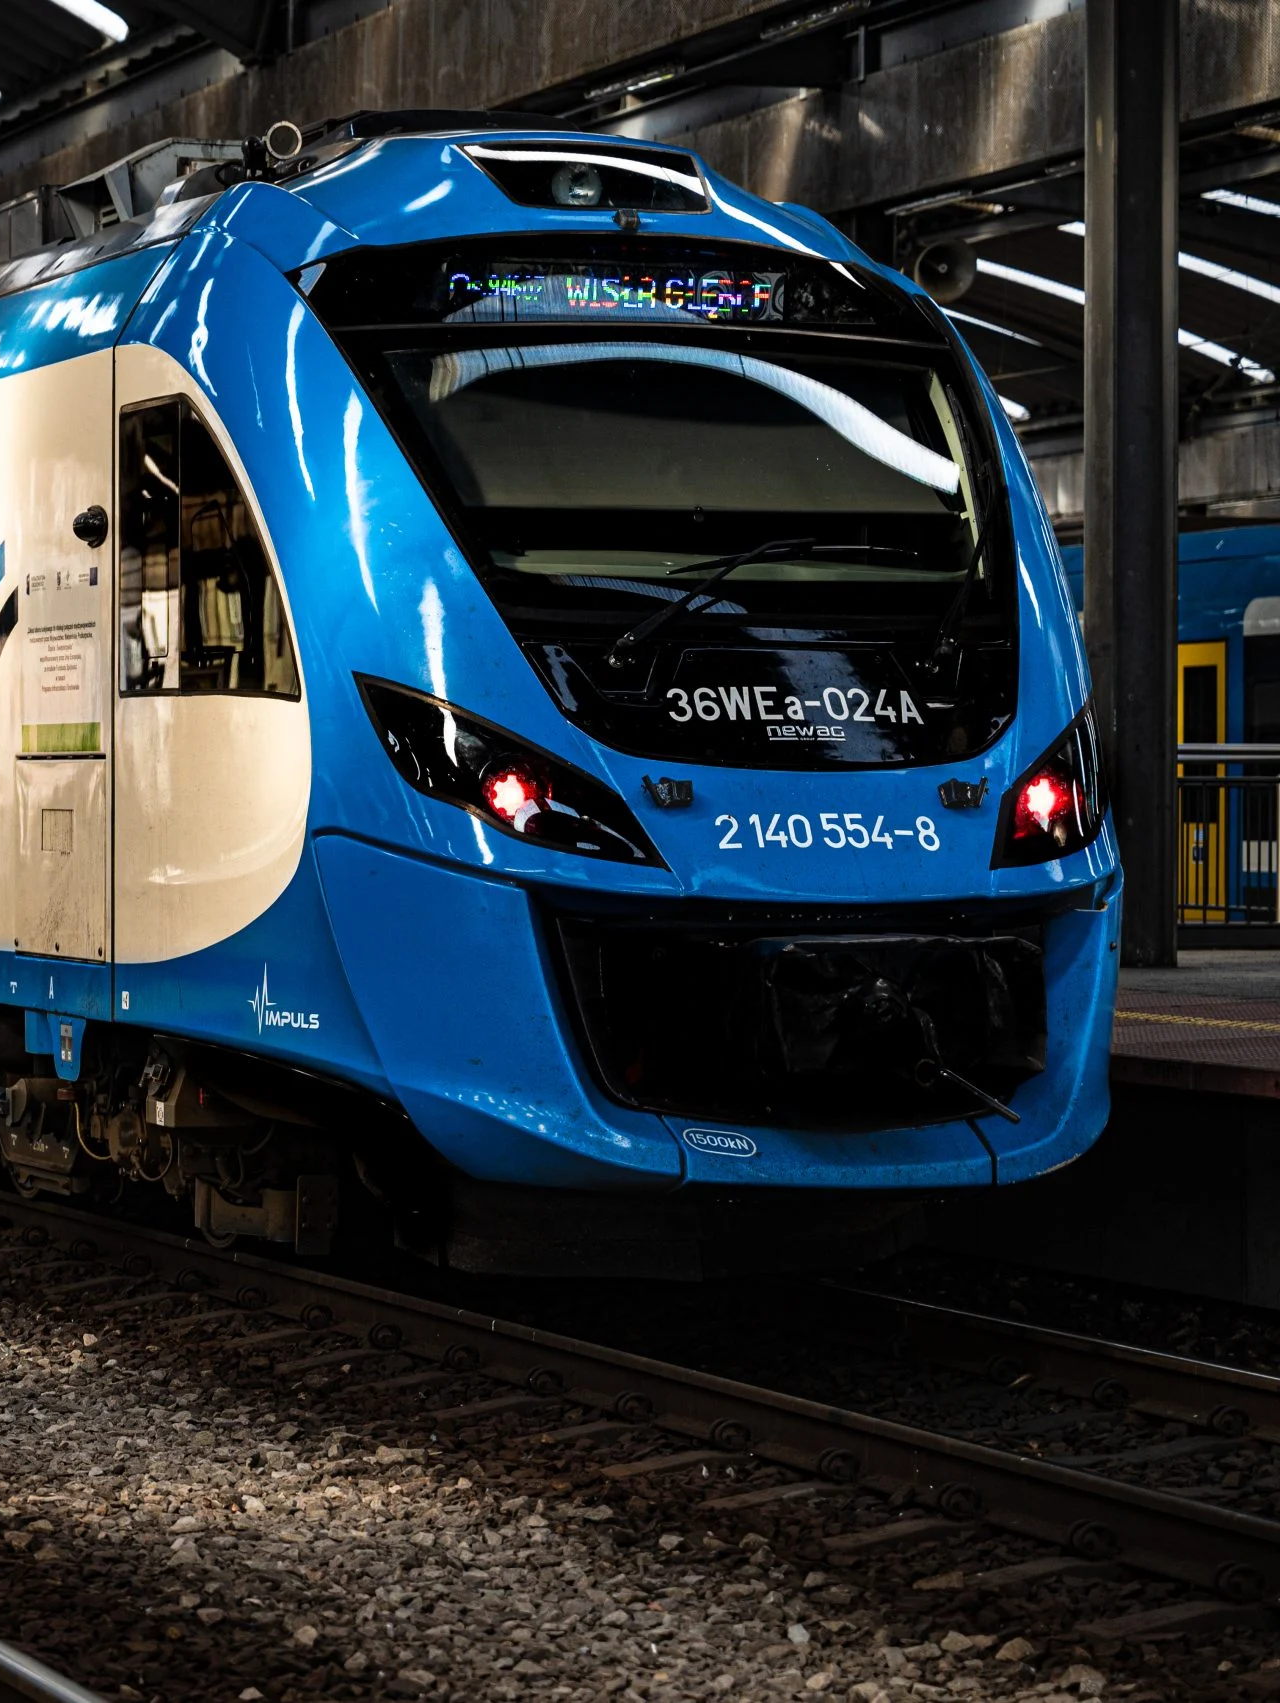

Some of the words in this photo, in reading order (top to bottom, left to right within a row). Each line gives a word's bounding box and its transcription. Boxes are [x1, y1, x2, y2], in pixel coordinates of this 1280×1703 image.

[666, 686, 925, 725] 36WEa-024A
[714, 814, 743, 849] 2
[749, 813, 813, 849] 140
[819, 812, 941, 852] 554-8
[265, 1009, 320, 1030] IMPULS
[688, 1132, 750, 1151] 1500kN
